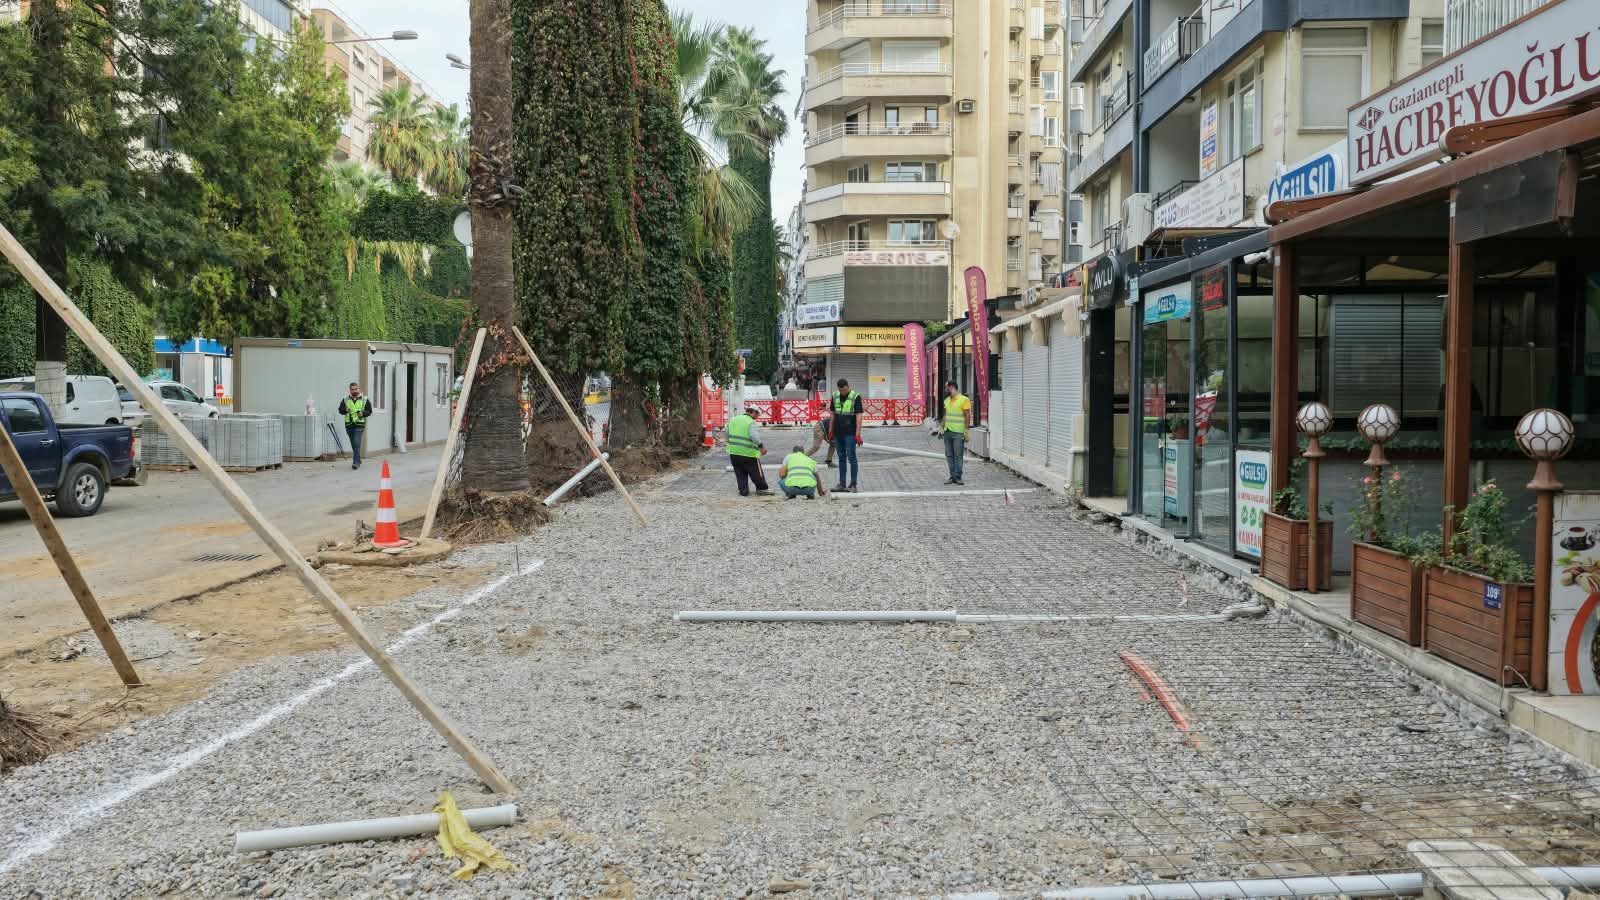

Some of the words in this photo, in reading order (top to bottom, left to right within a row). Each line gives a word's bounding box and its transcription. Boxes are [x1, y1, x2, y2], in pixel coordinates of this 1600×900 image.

[1355, 27, 1600, 174] HACIBEYOĞLU
[1389, 64, 1465, 115] Gaziantepli
[856, 333, 877, 341] DEMET
[879, 333, 906, 341] KURUYE
